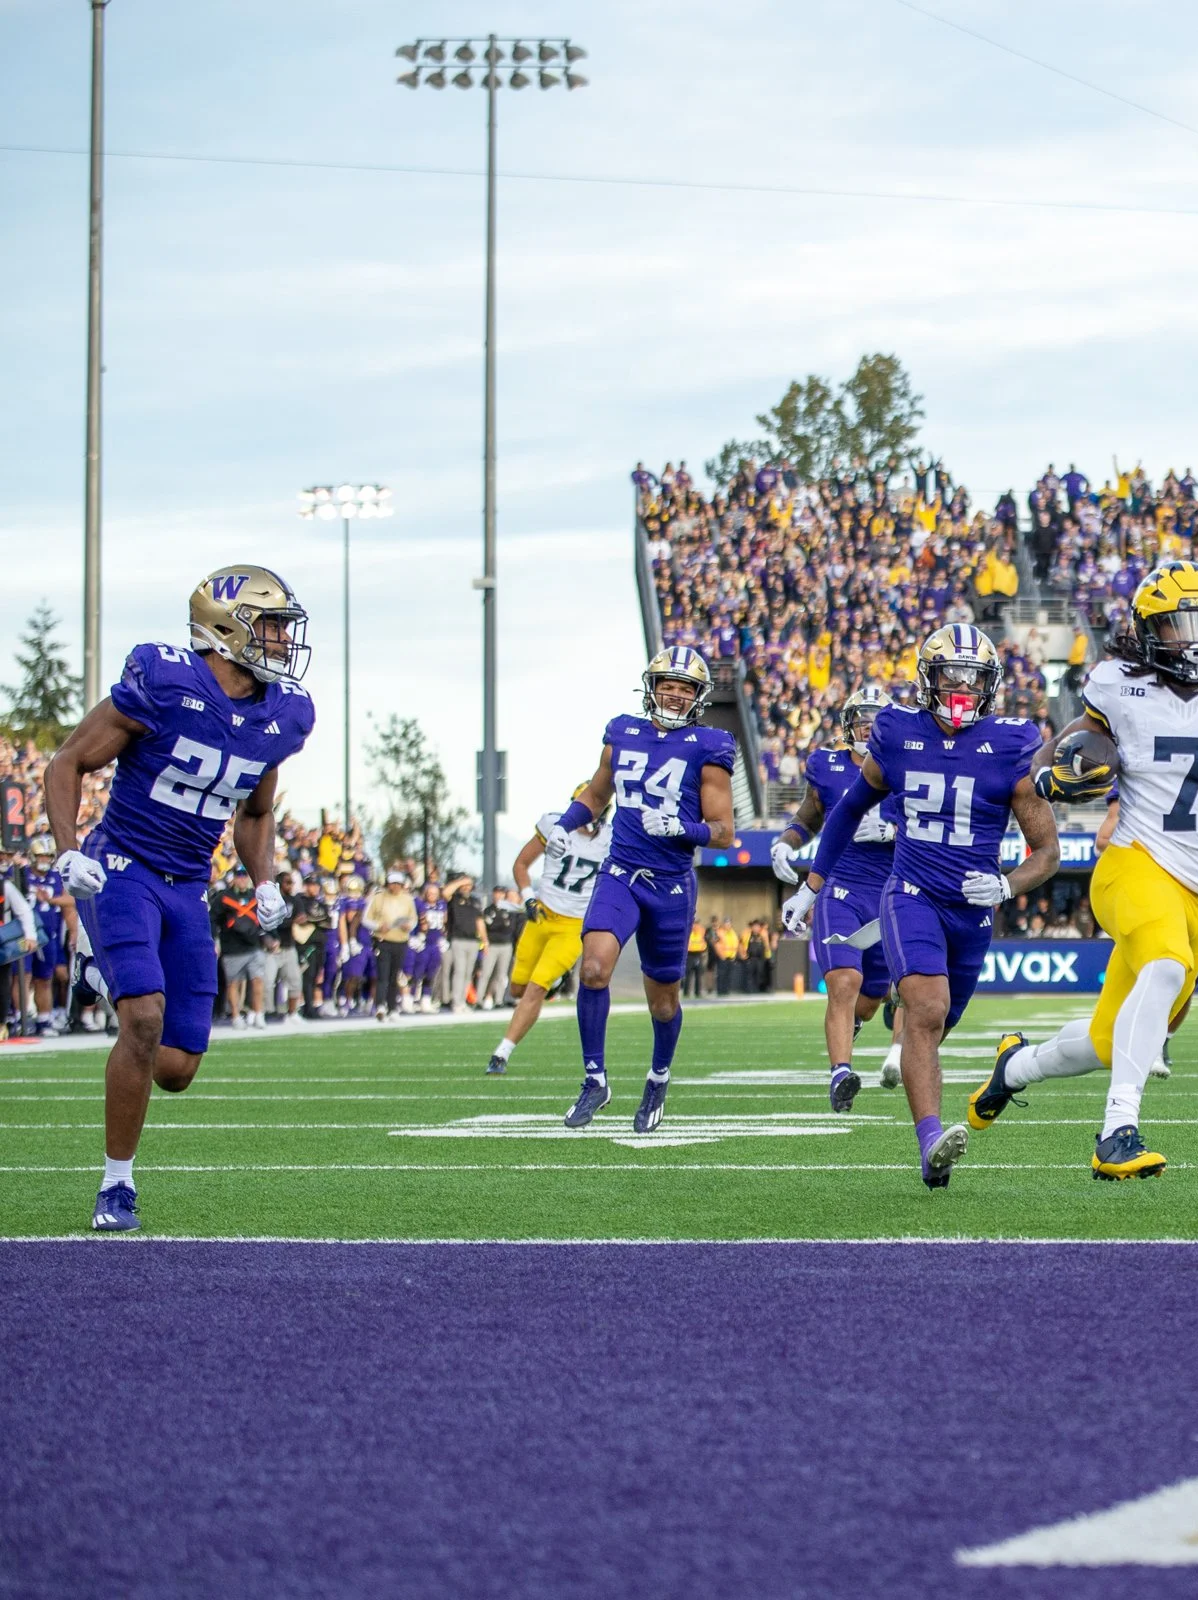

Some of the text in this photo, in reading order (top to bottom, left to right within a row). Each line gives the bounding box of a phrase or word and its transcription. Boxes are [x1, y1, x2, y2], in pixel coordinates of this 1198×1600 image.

[212, 576, 249, 600] W
[232, 714, 245, 727] W
[943, 740, 955, 750] W
[150, 735, 267, 820] 25
[614, 750, 688, 816] 24
[6, 786, 24, 825] 2
[904, 771, 975, 846] 21
[106, 854, 132, 871] W
[552, 853, 600, 894] 17
[609, 865, 626, 877] W
[833, 886, 849, 900] W
[903, 881, 920, 896] W
[978, 952, 1078, 982] avax
